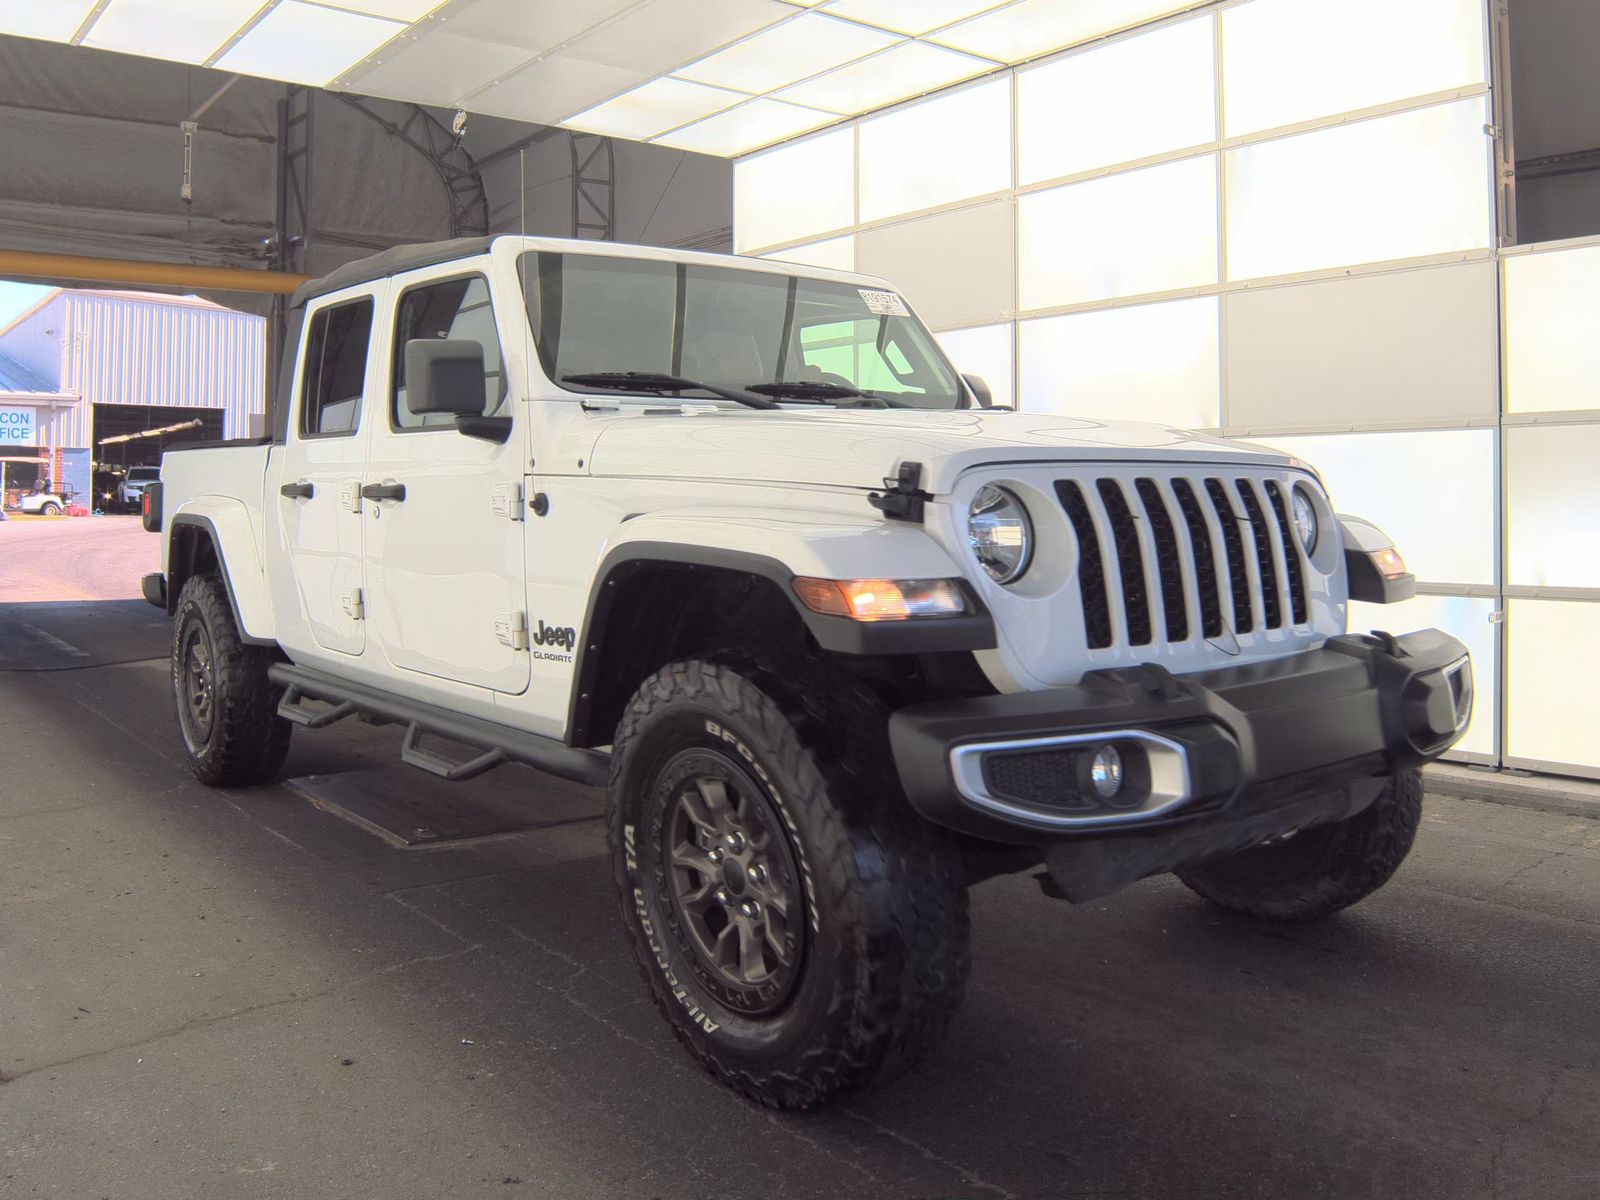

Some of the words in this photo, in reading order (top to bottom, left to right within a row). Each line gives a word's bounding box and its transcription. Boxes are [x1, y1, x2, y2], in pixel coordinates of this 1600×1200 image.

[0, 412, 29, 424] CON
[533, 619, 576, 652] Jeep
[624, 825, 637, 872] T/A
[633, 888, 720, 1034] All-Terrain
